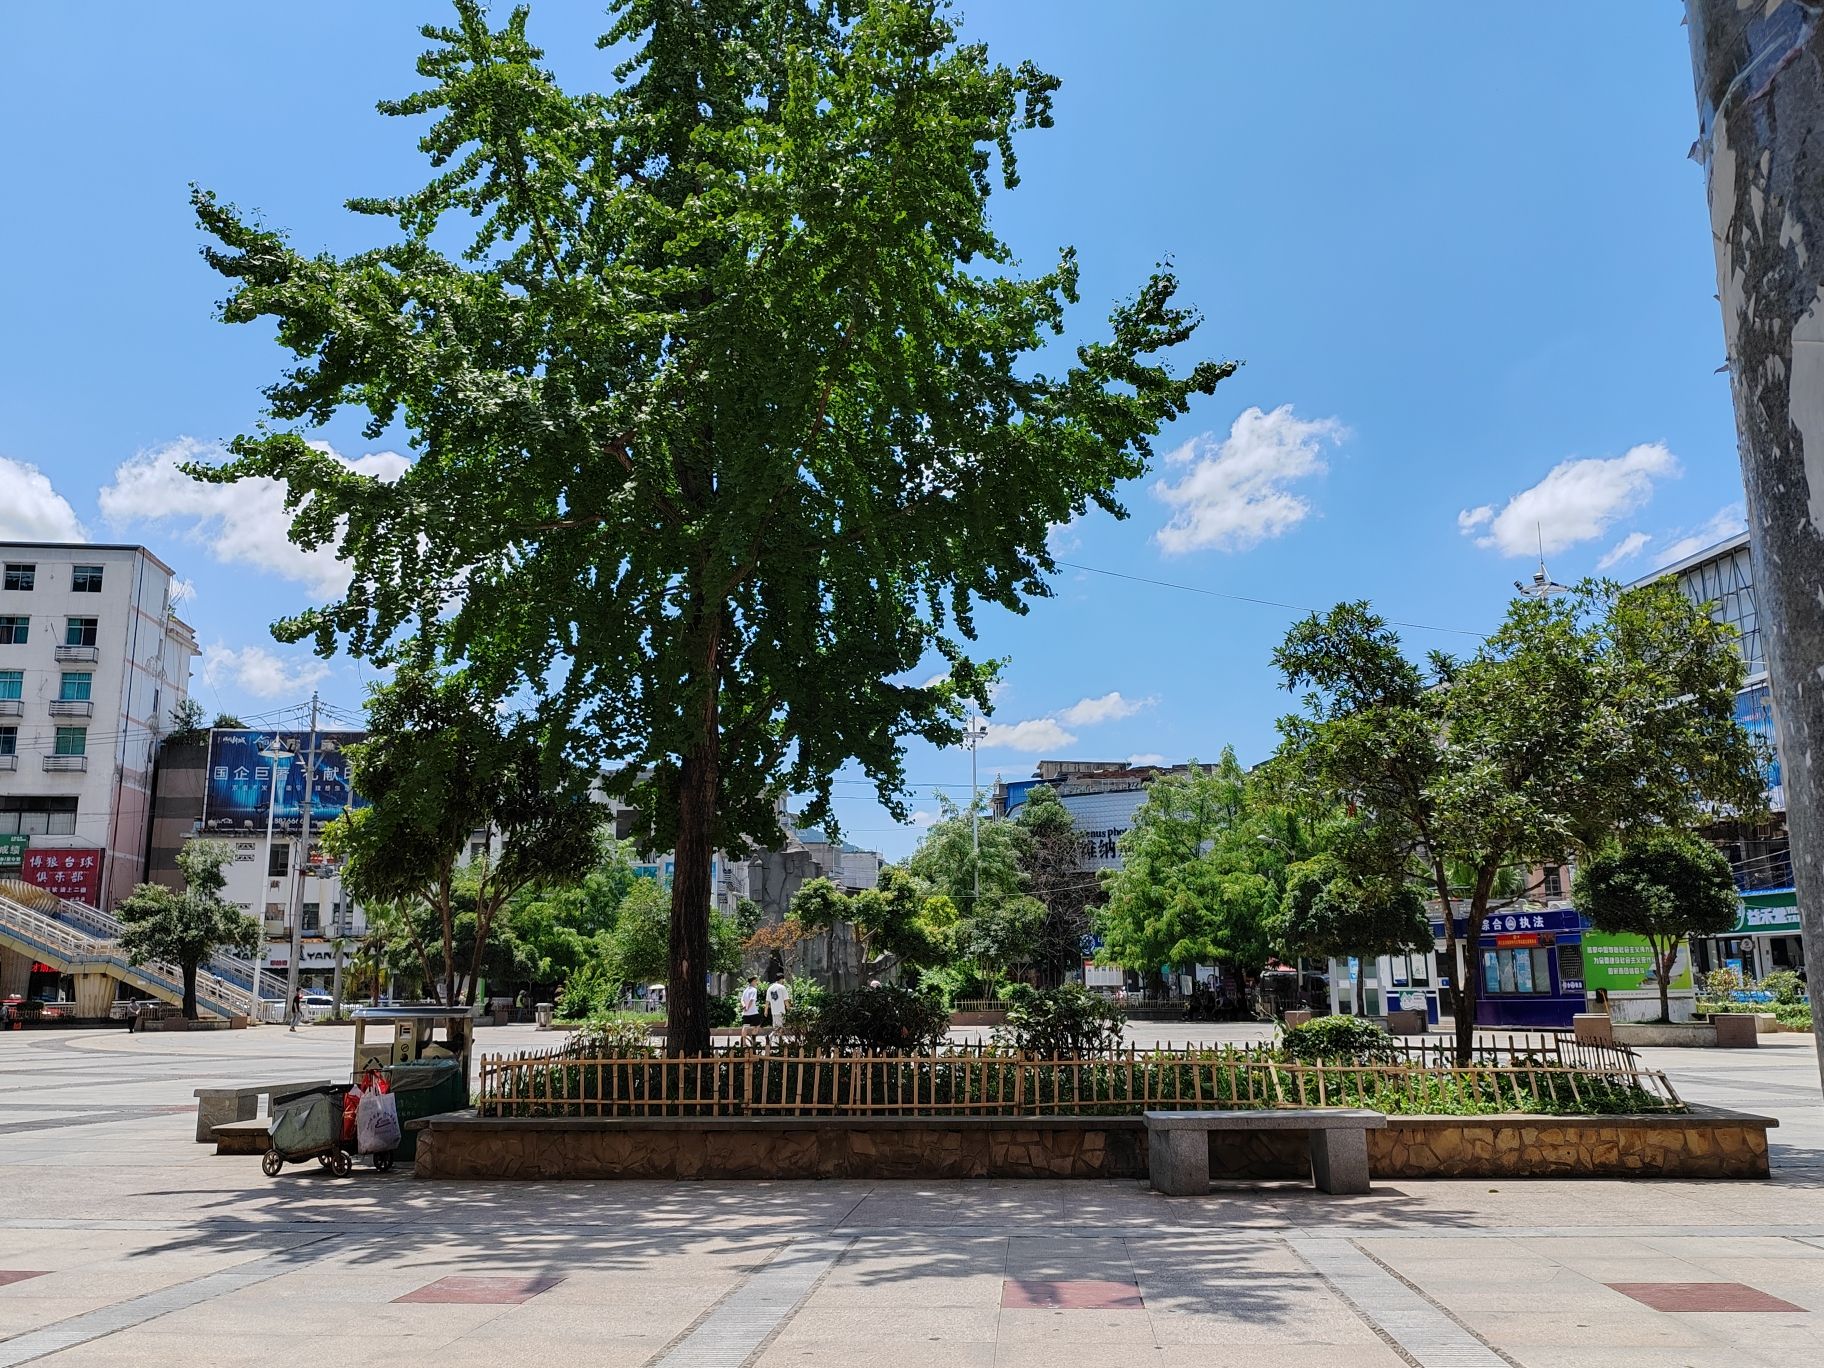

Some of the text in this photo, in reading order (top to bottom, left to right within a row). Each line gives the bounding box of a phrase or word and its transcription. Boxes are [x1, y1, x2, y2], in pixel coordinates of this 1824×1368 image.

[214, 766, 290, 781] 国企巨著
[36, 871, 84, 883] 俱乐部
[1519, 916, 1544, 929] 执法
